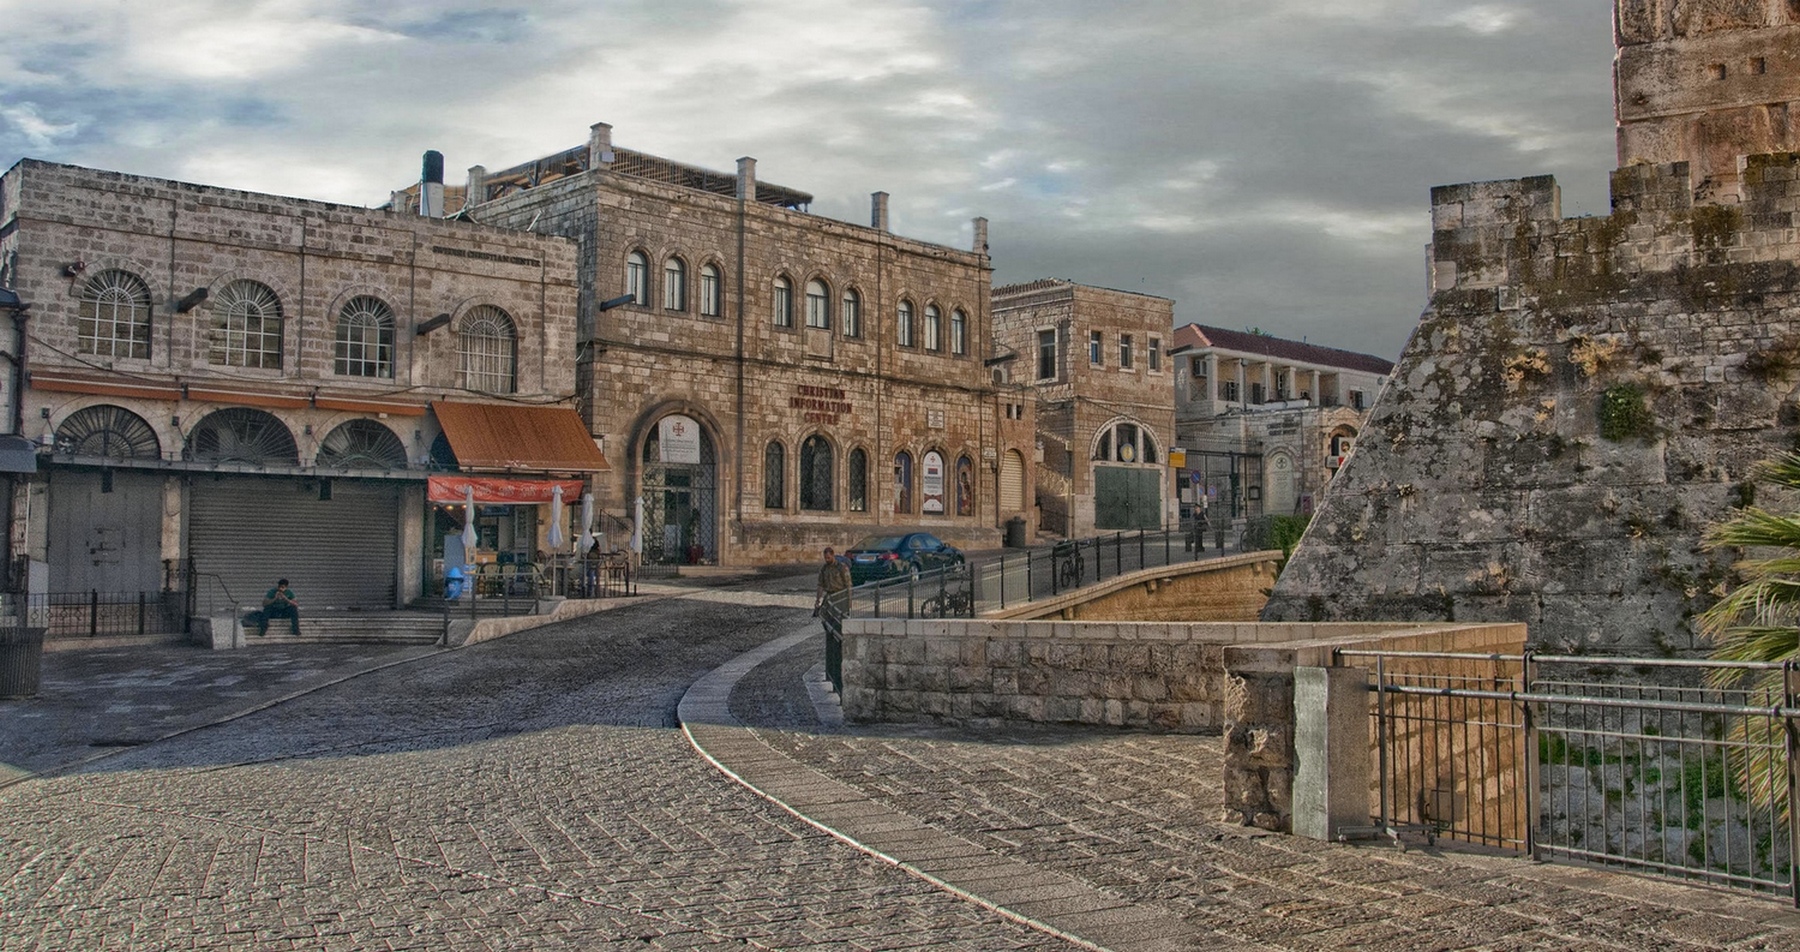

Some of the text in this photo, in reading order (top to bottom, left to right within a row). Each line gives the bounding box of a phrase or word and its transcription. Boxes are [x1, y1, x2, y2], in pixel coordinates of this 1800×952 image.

[467, 250, 509, 263] CHRISTIAN
[798, 385, 845, 400] CHRISTIAN
[789, 397, 852, 414] INFORMATION
[804, 412, 839, 425] CENTRE
